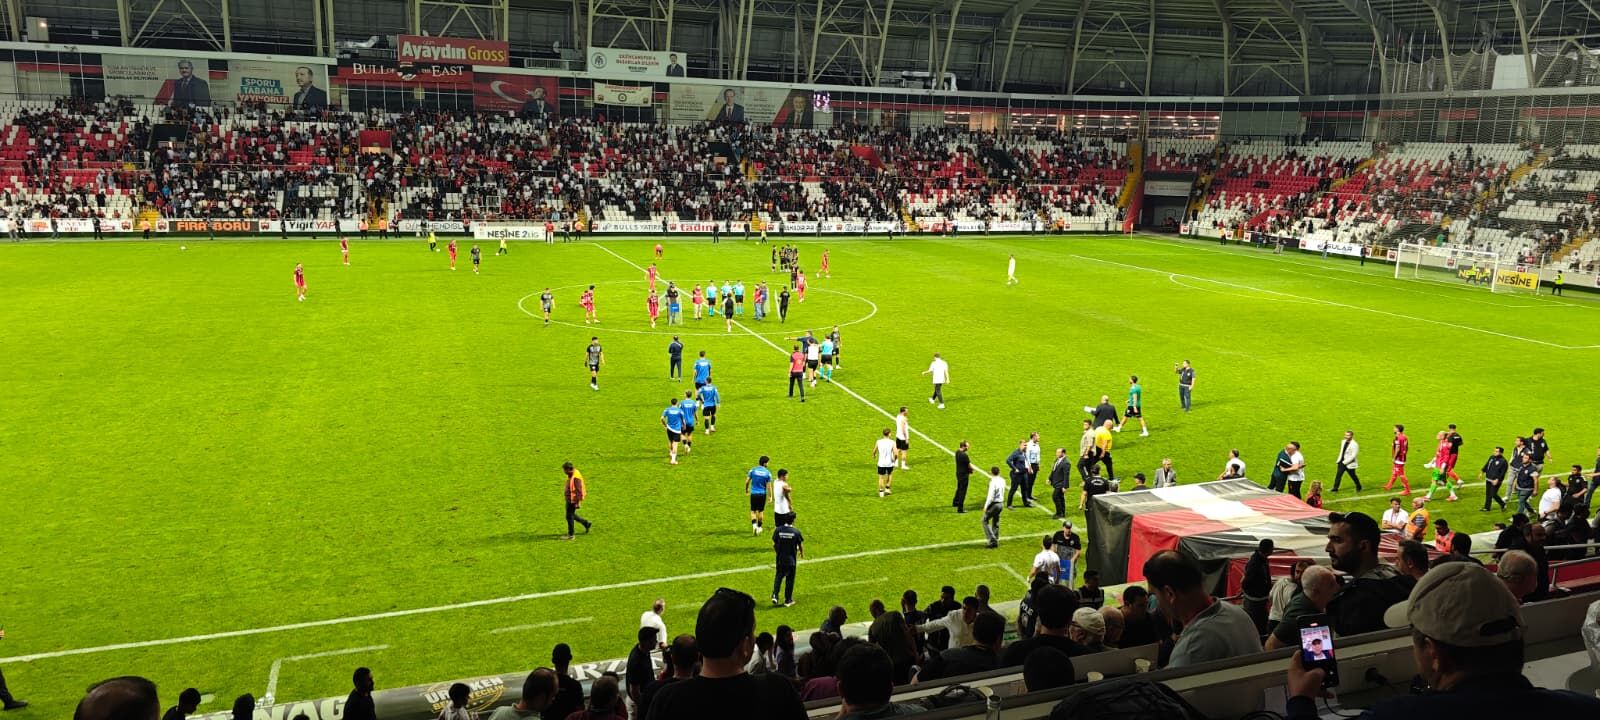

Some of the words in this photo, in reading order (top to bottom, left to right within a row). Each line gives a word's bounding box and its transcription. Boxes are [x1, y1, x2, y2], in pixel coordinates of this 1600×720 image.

[402, 41, 466, 61] Ayaydın
[468, 45, 505, 62] Gross
[352, 62, 387, 75] BULL
[432, 64, 464, 76] EAST
[245, 78, 276, 87] SPORU
[243, 86, 280, 95] TABANA
[176, 221, 211, 231] FIRA
